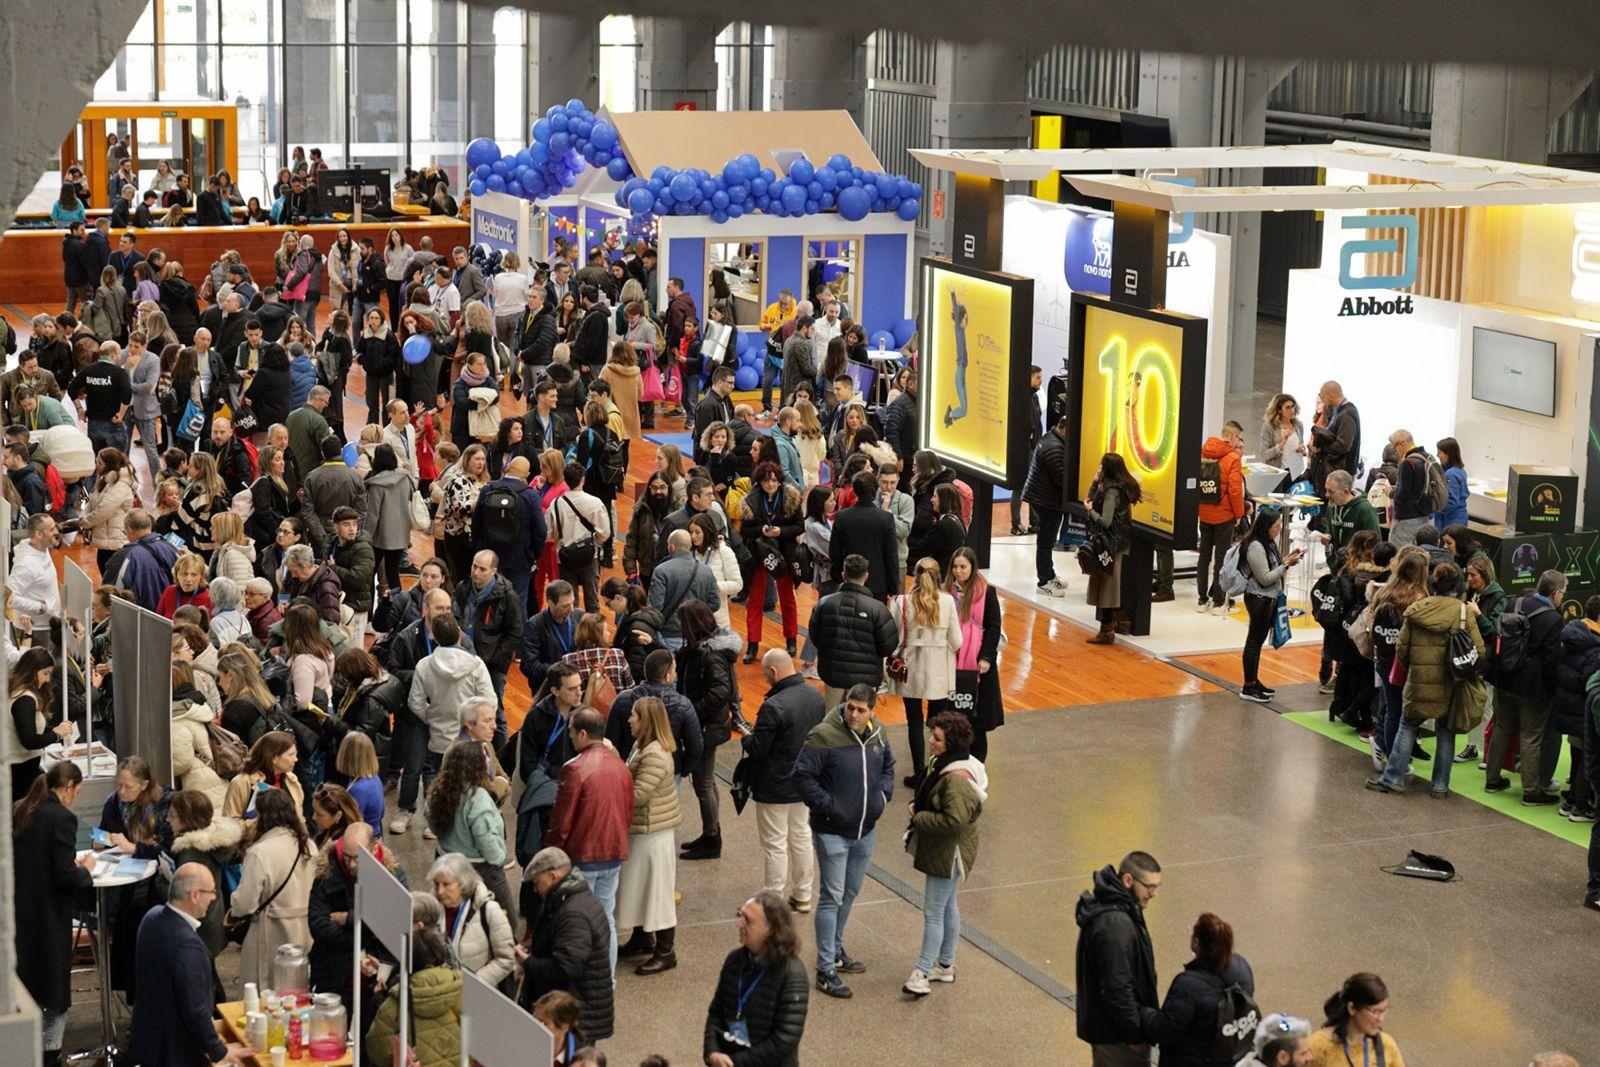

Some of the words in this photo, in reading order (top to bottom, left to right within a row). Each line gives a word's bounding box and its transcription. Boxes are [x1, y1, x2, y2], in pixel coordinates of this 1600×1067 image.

[478, 215, 514, 244] Medtronic
[1083, 264, 1098, 275] novo
[1337, 295, 1414, 317] Abbott
[1098, 337, 1179, 474] 10
[954, 701, 974, 710] UP!
